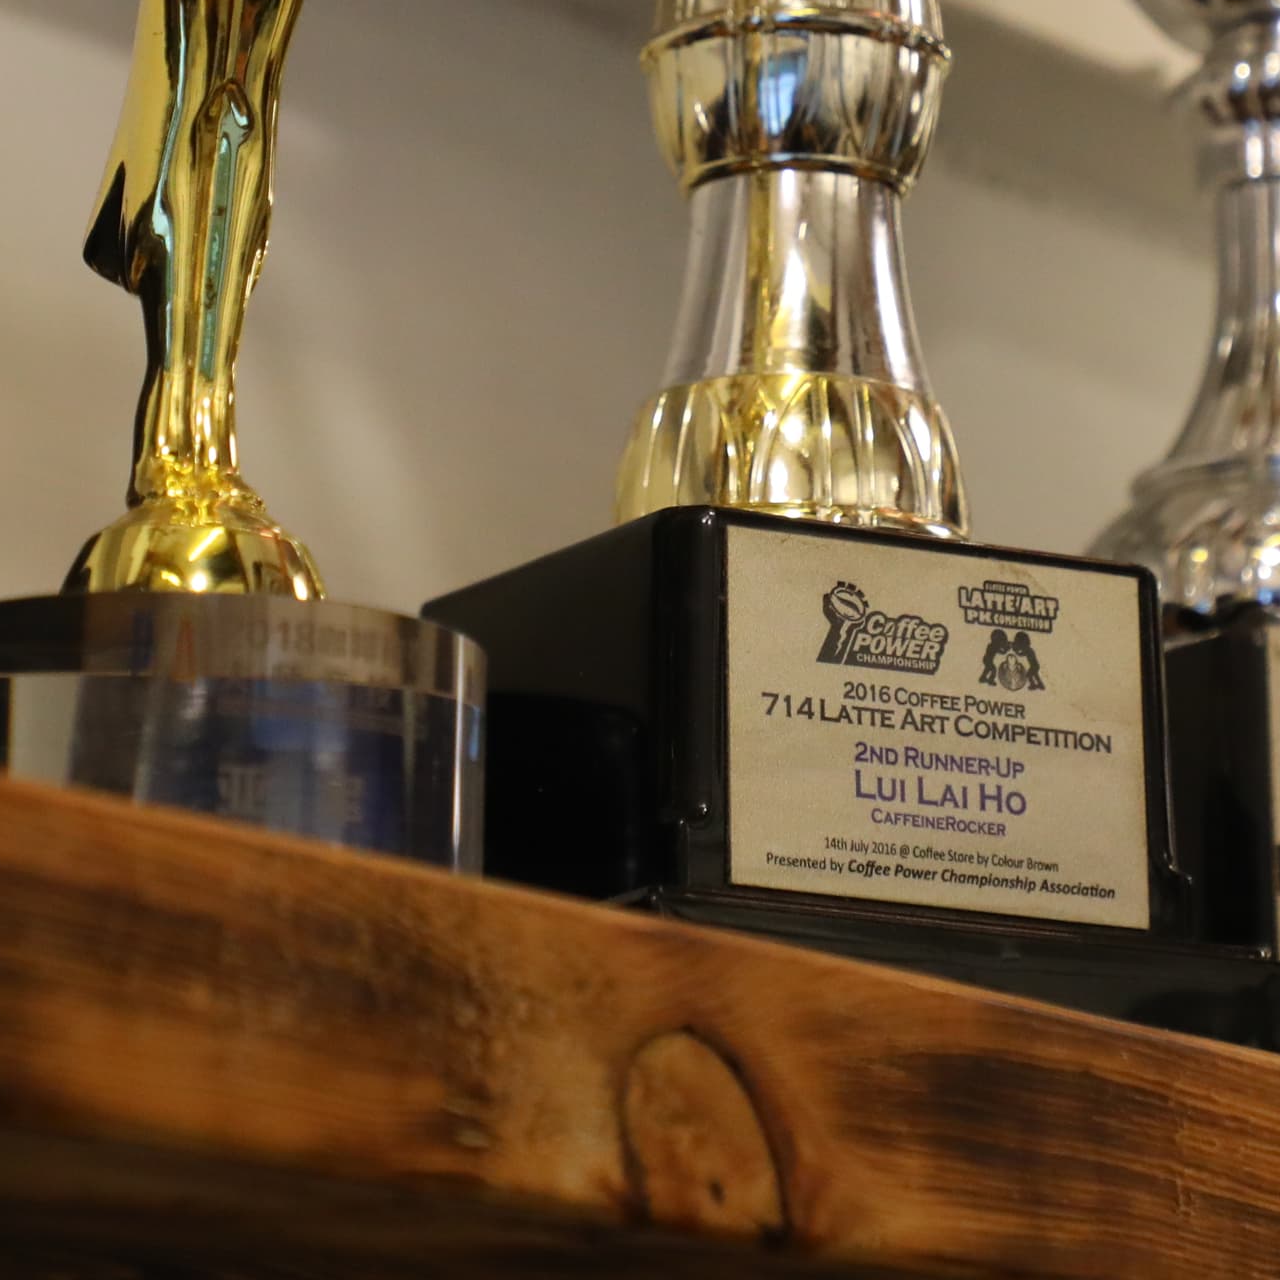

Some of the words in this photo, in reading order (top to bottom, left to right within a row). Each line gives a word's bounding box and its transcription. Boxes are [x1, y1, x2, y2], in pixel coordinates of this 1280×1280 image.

[852, 633, 941, 661] POWER
[866, 613, 946, 643] Coffee
[856, 653, 937, 671] CHAMPIONSHIP
[843, 681, 891, 704] 2016
[894, 687, 961, 712] COFFEE
[964, 695, 1026, 720] POWER
[761, 691, 815, 720] 714
[820, 698, 896, 729] LATTE
[900, 708, 950, 734] ART
[954, 714, 1112, 754] COMPETITION
[854, 741, 899, 766] 2ND
[904, 746, 1025, 780] RUNNER-UP
[854, 769, 907, 803] LUI
[917, 776, 969, 809] LAI
[979, 783, 1027, 816] HO
[825, 836, 847, 852] 14th
[850, 839, 869, 856] July
[872, 841, 897, 856] 2016
[899, 845, 910, 859] @
[913, 846, 945, 861] Coffee
[948, 849, 974, 864] Store
[977, 851, 989, 868] by
[992, 854, 1025, 869] Colour
[1027, 857, 1059, 872] Brown
[766, 852, 826, 870] Presented
[830, 858, 844, 873] by
[848, 859, 890, 877] Coffee
[894, 865, 937, 882] Power
[941, 869, 1036, 893] Championship
[1040, 879, 1115, 899] Association
